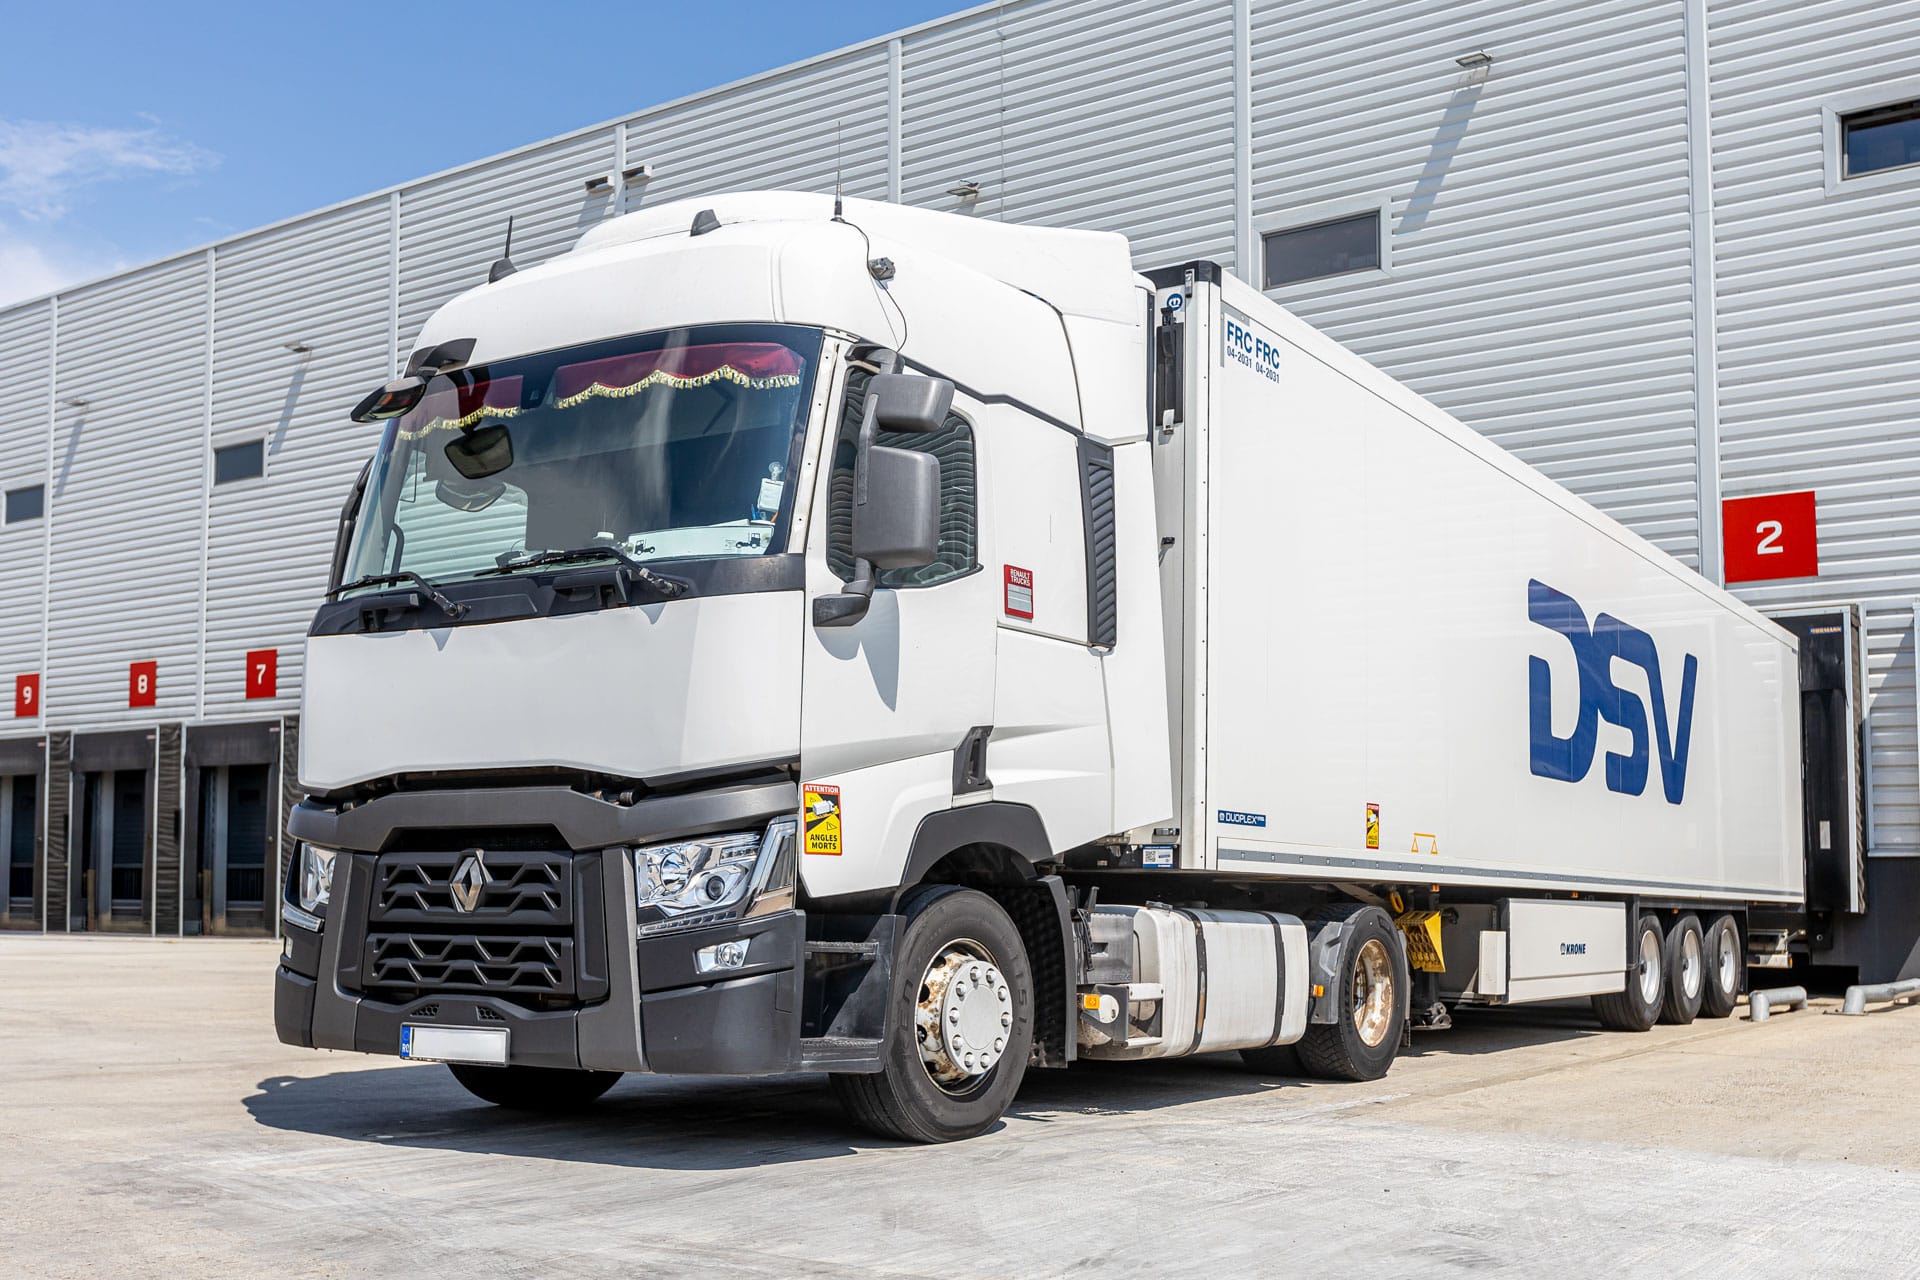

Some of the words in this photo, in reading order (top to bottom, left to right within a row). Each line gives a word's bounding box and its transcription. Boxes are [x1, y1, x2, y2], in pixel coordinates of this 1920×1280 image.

[1227, 320, 1252, 353] FRC
[1256, 337, 1280, 369] FRC
[1227, 345, 1252, 368] 04-2031
[1256, 361, 1280, 384] 04-2031
[1756, 520, 1784, 555] 2
[1010, 568, 1030, 580] RENAULT
[1011, 575, 1031, 586] TRUCKS
[256, 664, 267, 684] 7
[137, 674, 148, 694] 8
[23, 686, 32, 704] 9
[1528, 578, 1698, 805] DSV
[805, 784, 839, 794] ATTENTION
[1225, 812, 1257, 824] DUOPLEX
[810, 833, 838, 842] ANGLES
[811, 842, 837, 850] MORTS
[1566, 943, 1586, 954] KRONE
[401, 1043, 410, 1053] RO
